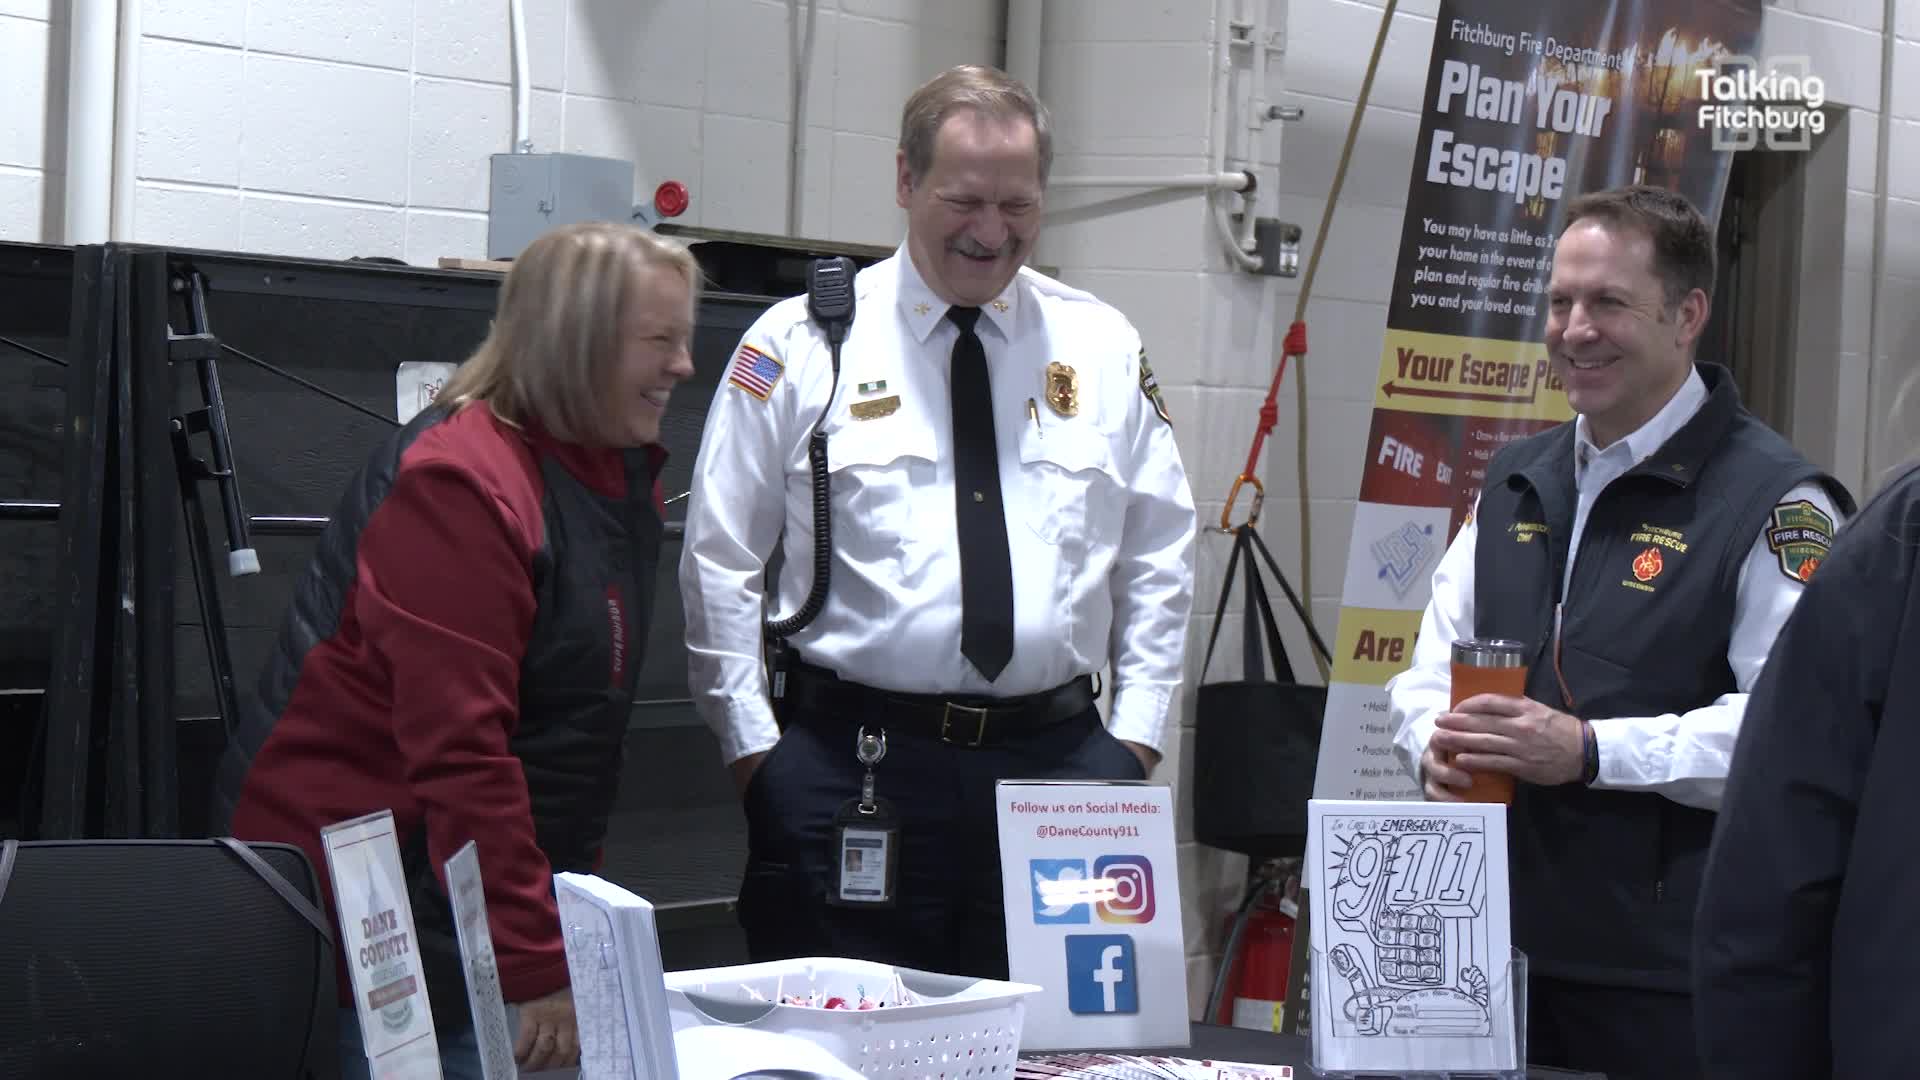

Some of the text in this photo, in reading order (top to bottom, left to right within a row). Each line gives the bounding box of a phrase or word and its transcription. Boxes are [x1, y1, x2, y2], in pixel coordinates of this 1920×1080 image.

[1450, 19, 1623, 70] Fitchburg Fire Department
[1436, 59, 1612, 138] Plan Your
[1426, 129, 1567, 204] Escape
[1423, 218, 1446, 236] You
[1448, 225, 1472, 242] may
[1473, 224, 1497, 241] have
[1498, 231, 1509, 243] as
[1510, 229, 1533, 245] little
[1534, 237, 1546, 248] as
[1418, 245, 1448, 260] your
[1450, 245, 1478, 263] home
[1480, 249, 1489, 264] in
[1490, 251, 1505, 266] the
[1506, 256, 1536, 270] event
[1536, 256, 1546, 270] of
[1414, 265, 1443, 284] plan
[1445, 270, 1467, 285] and
[1468, 274, 1501, 291] regular
[1503, 274, 1521, 292] fire
[1411, 293, 1436, 307] you
[1438, 293, 1459, 308] and
[1461, 299, 1483, 313] your
[1484, 296, 1512, 314] loved
[1396, 347, 1563, 393] Your Escape Pla
[1378, 435, 1424, 479] FIRE
[1630, 533, 1688, 553] FIRE RESCUE
[1774, 529, 1832, 547] FIRE RESCU
[1353, 629, 1405, 663] Are
[1011, 801, 1161, 814] Follow us on Social Media:
[1036, 825, 1140, 839] @DaneCounty911
[1380, 819, 1449, 832] EMERGENCY
[361, 909, 398, 939] DANE
[360, 932, 409, 970] COUNTY
